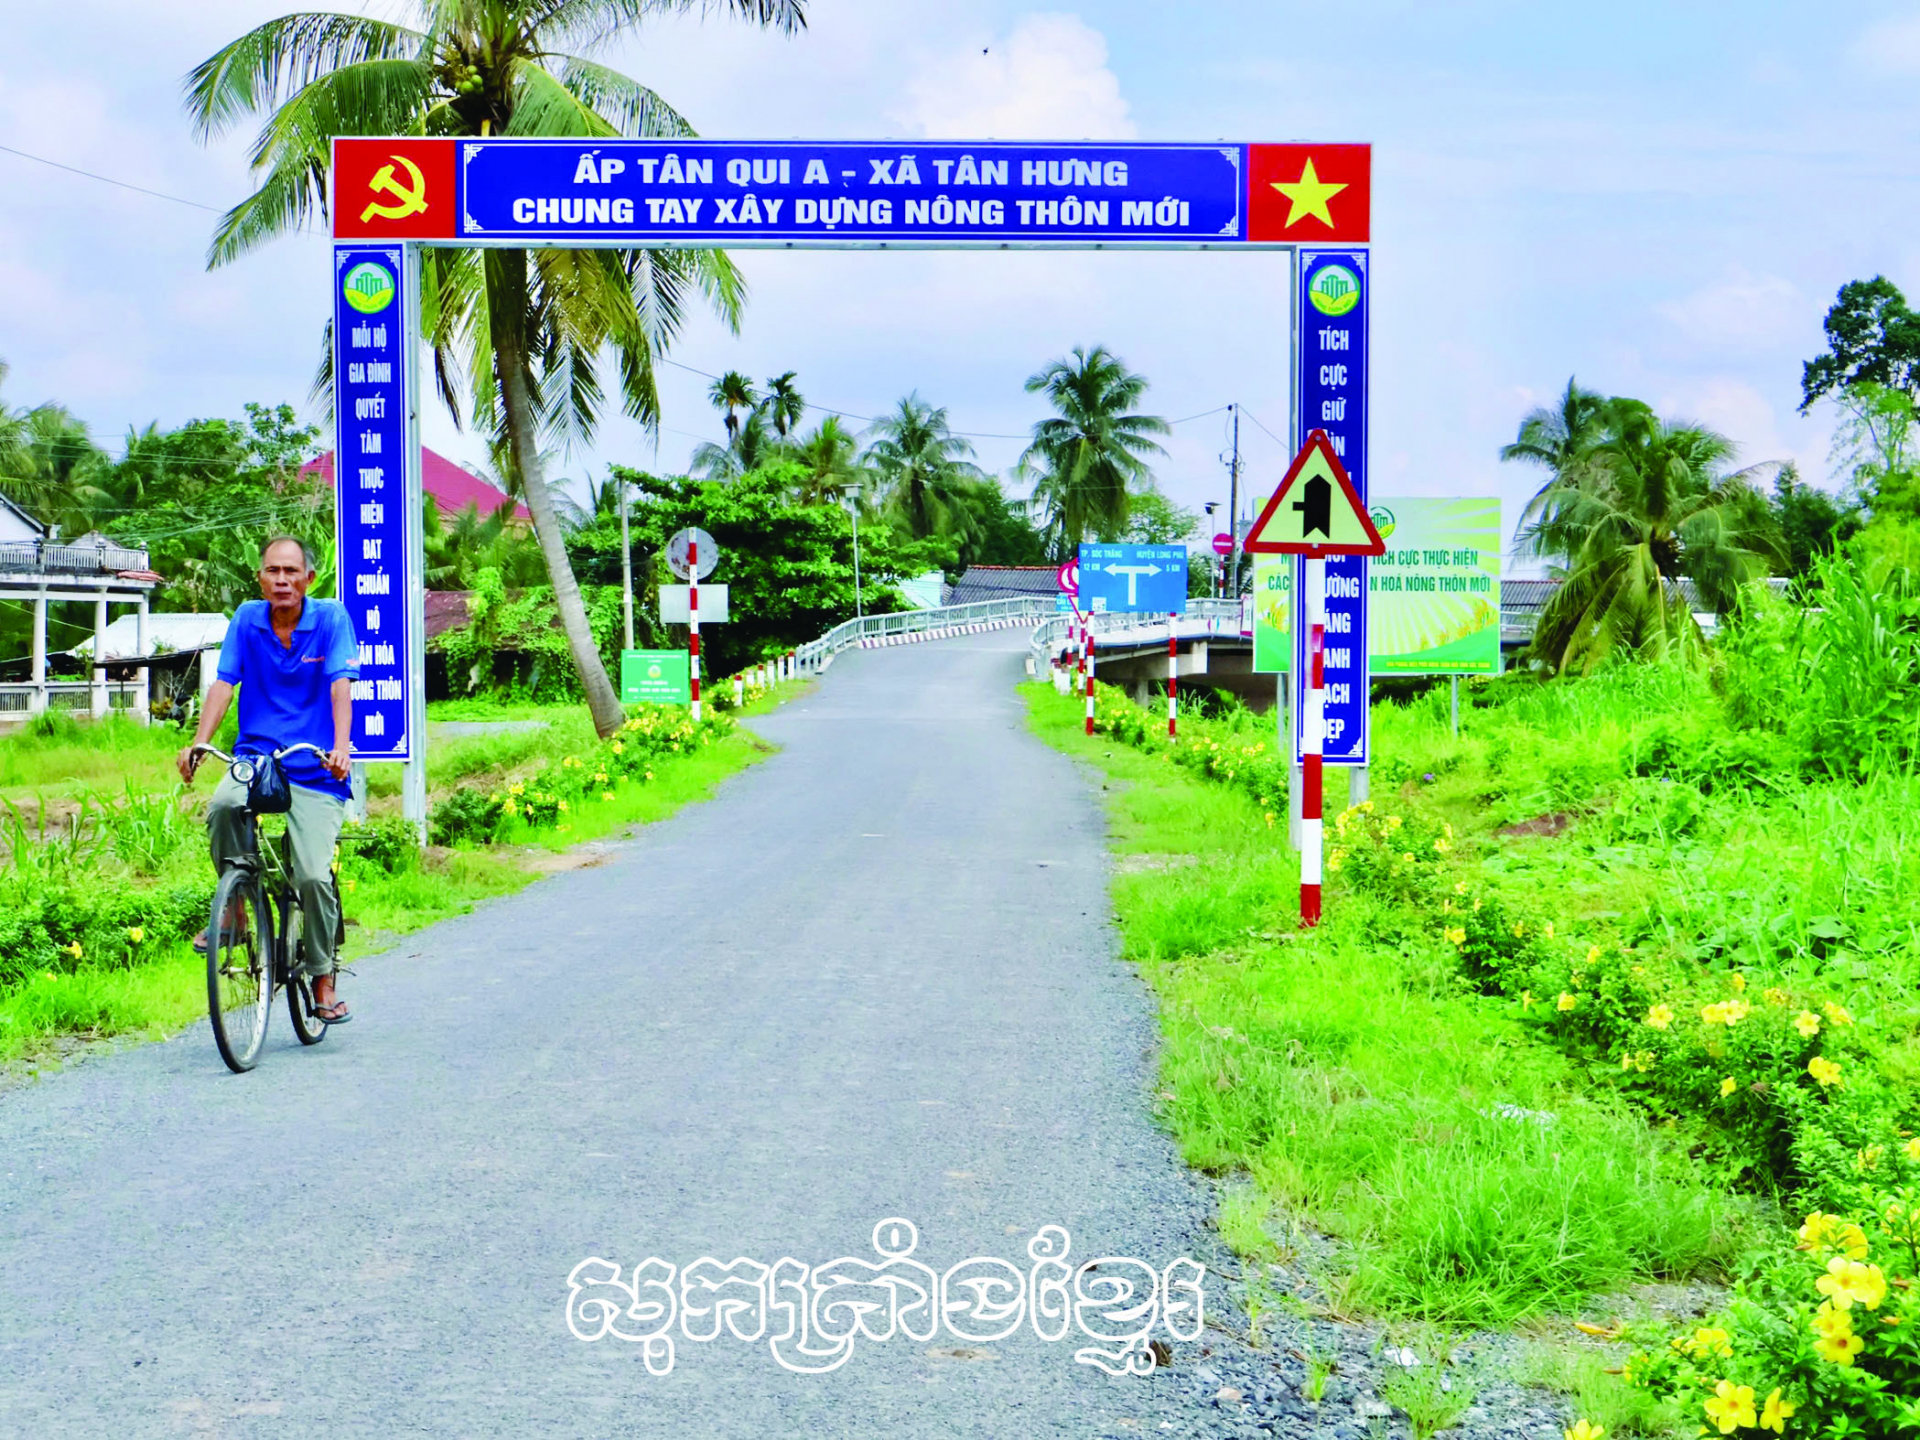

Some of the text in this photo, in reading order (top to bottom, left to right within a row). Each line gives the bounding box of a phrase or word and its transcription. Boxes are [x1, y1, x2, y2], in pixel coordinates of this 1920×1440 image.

[574, 150, 625, 184] ẤP
[638, 154, 712, 184] TÂN
[727, 158, 789, 186] QUI
[803, 159, 829, 184] A
[869, 155, 921, 185] XÃ
[933, 154, 1008, 185] TÂN
[1022, 158, 1127, 186] HƯNG
[514, 195, 1189, 229] CHUNG TAY XÂY DỰNG NÔNG THÔN MỚI
[373, 323, 387, 352] HỘ
[1319, 326, 1349, 350] TÍCH
[349, 358, 391, 384] GIA ĐÌNH
[1320, 363, 1347, 390] CỰC
[355, 391, 386, 421] QUYẾT
[1322, 397, 1346, 421] GIỮ
[359, 429, 382, 454] TÂM
[358, 466, 384, 494] THỰC
[361, 499, 384, 529] HIỆN
[363, 539, 382, 564] ĐẠT
[1398, 549, 1419, 568] CỰC
[1422, 549, 1449, 569] THỰC
[1453, 548, 1477, 568] HIỆN
[357, 565, 389, 595] CHUẨN
[1405, 573, 1435, 592] NÔNG
[1439, 574, 1467, 592] THÔN
[1470, 574, 1491, 592] MỚI
[367, 605, 380, 634] HỘ
[1324, 608, 1351, 634] ÁNG
[357, 640, 396, 665] ĂN HÓA
[1323, 648, 1350, 669] ANH
[375, 675, 403, 701] THÔN
[1324, 683, 1350, 709] ẠCH
[365, 711, 384, 735] MỚI
